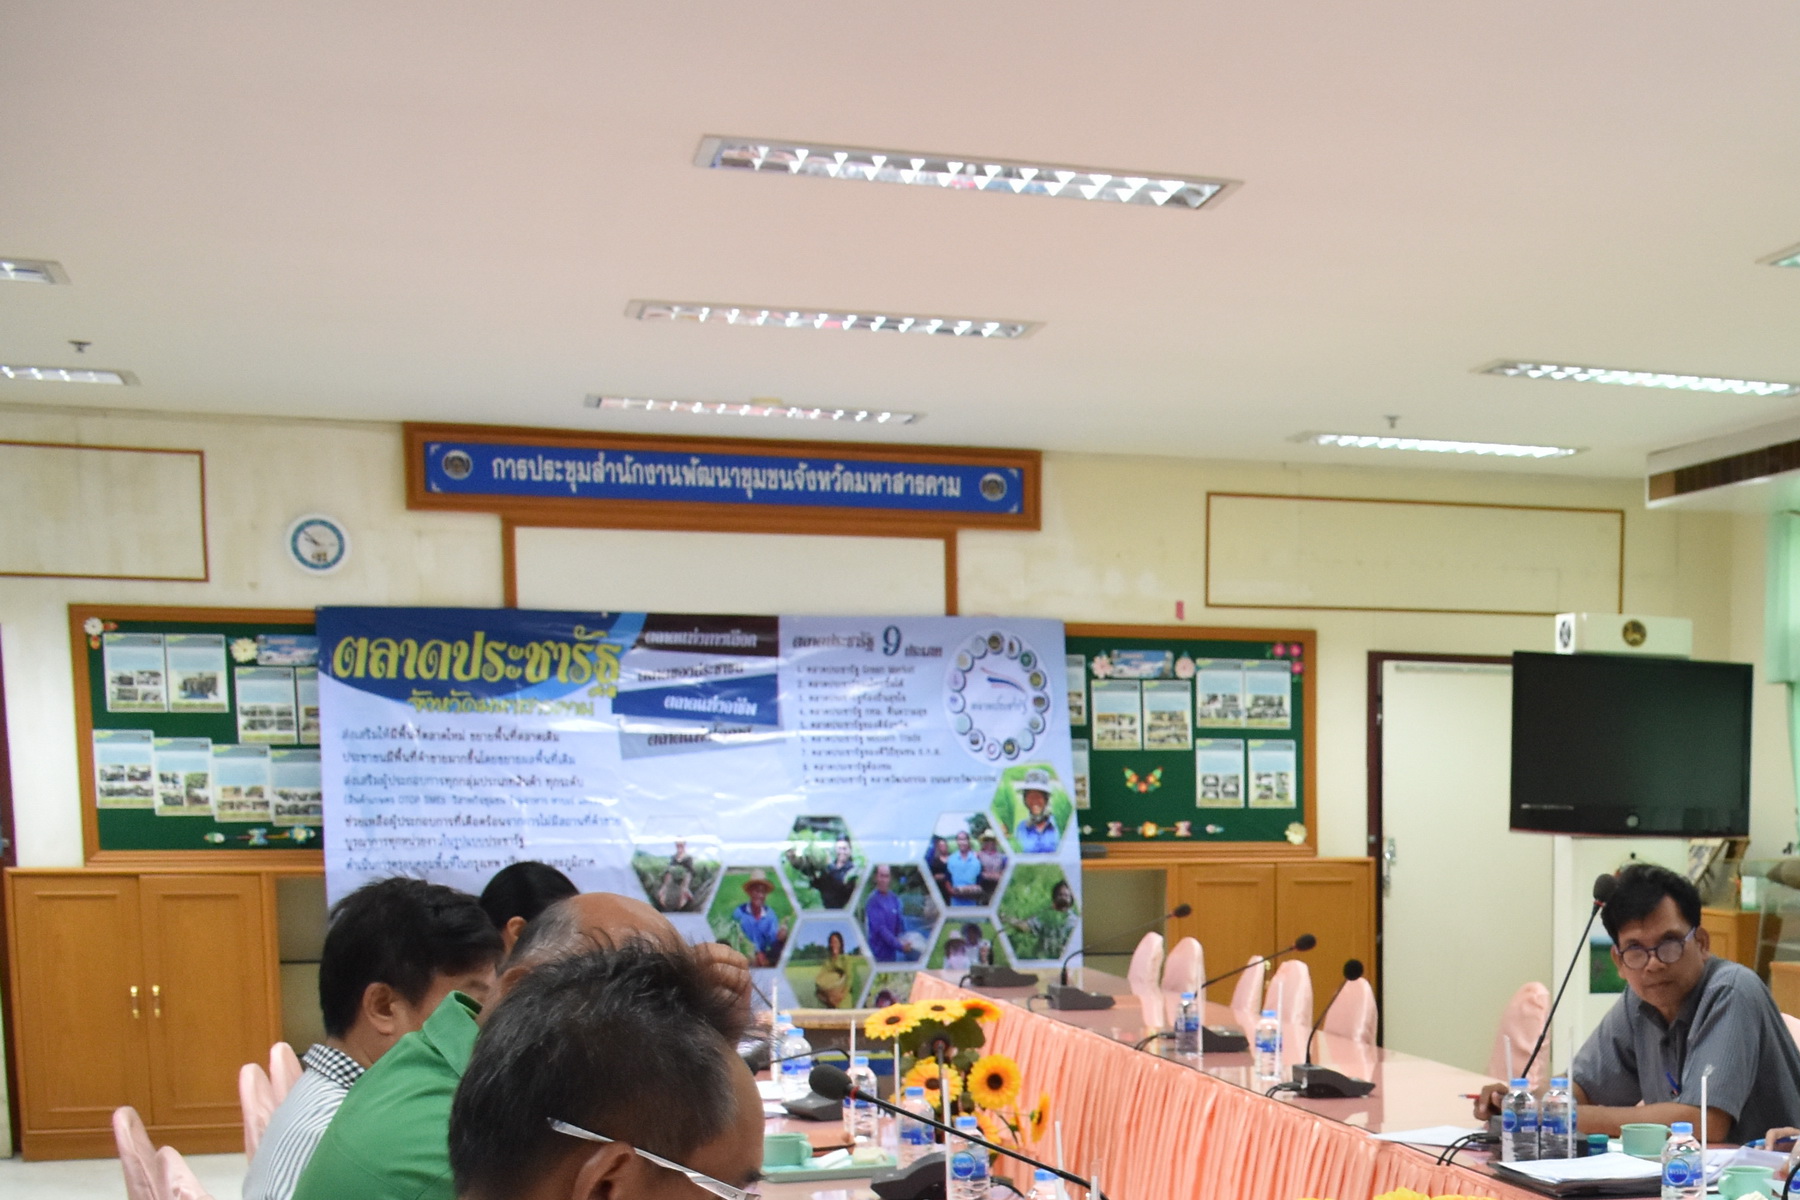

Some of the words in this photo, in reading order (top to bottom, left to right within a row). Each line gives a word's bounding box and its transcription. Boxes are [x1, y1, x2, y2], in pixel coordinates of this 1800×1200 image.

[882, 625, 902, 657] 9
[332, 625, 622, 698] ตลาดประชารัฐ
[407, 689, 594, 716] จังหวัดมหาสารคาม
